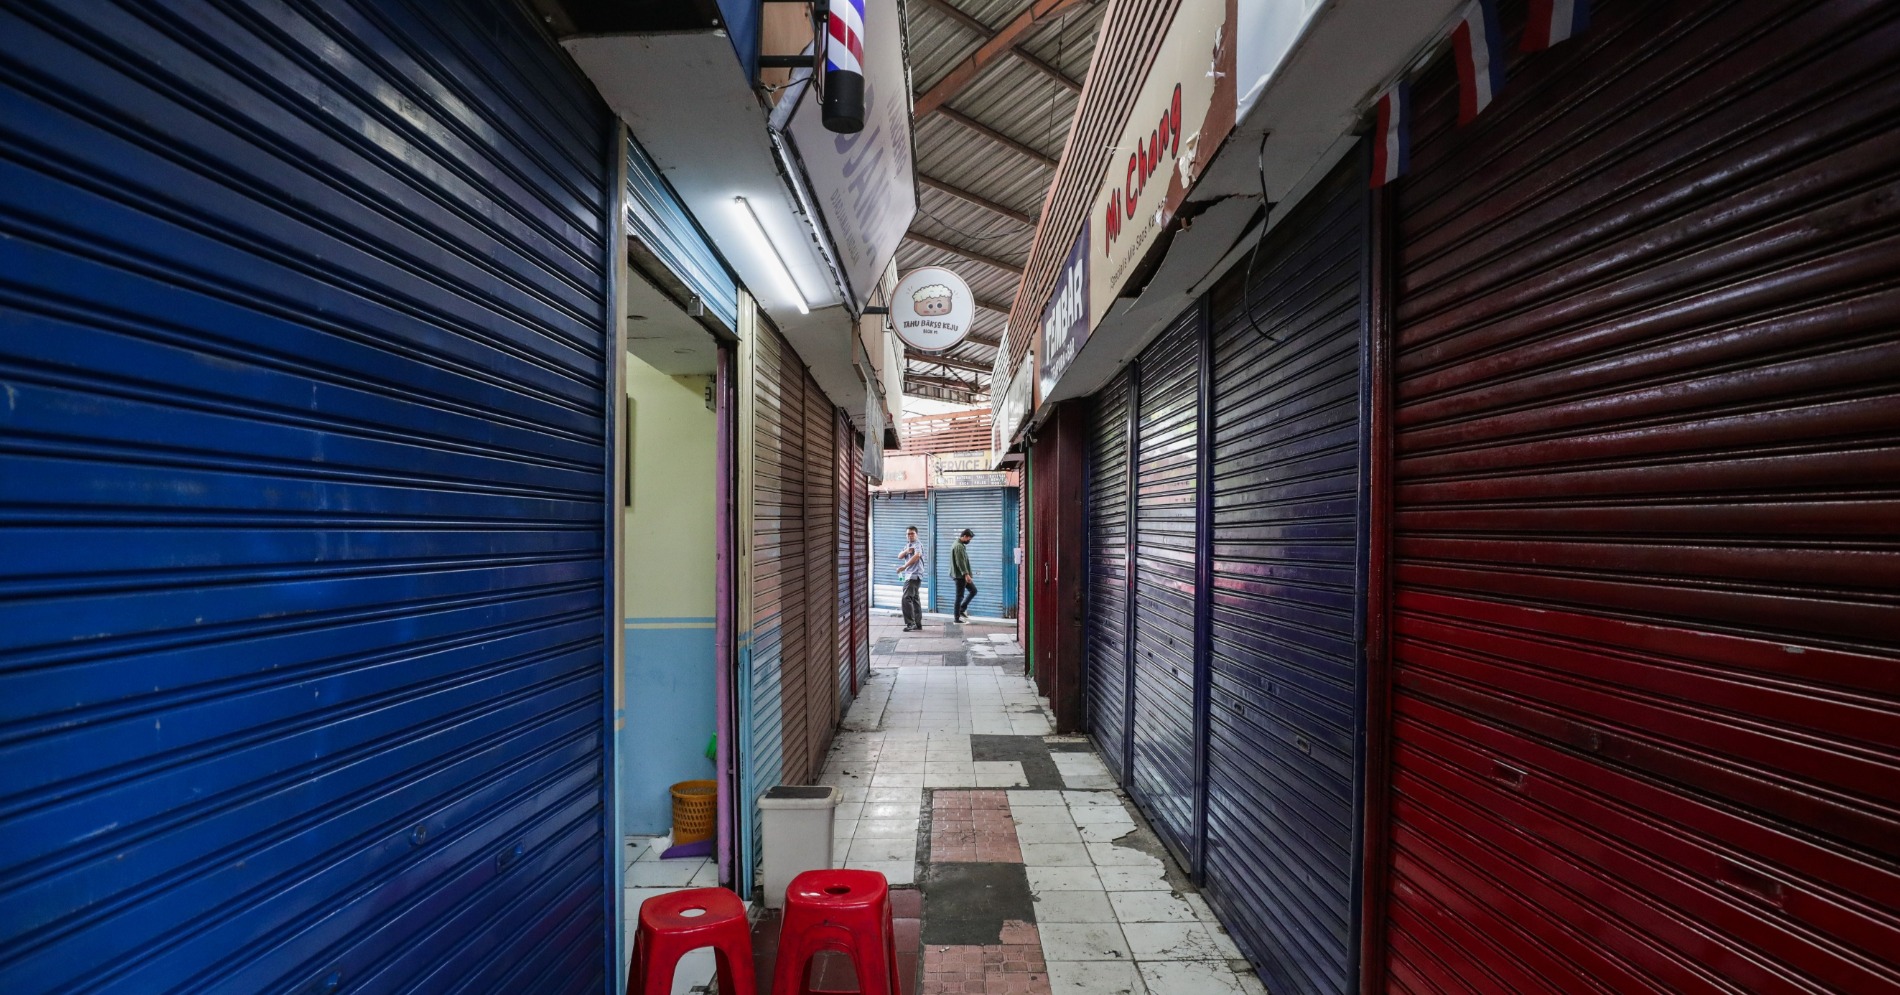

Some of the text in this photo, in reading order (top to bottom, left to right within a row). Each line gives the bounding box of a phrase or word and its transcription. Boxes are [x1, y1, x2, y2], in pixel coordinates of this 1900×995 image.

[886, 88, 909, 174] WAROENG
[1105, 187, 1121, 258] Mi
[1125, 82, 1182, 221] Chang
[942, 322, 958, 331] KEJU
[1045, 258, 1083, 366] TEMBAR
[934, 459, 980, 473] SERVICE
